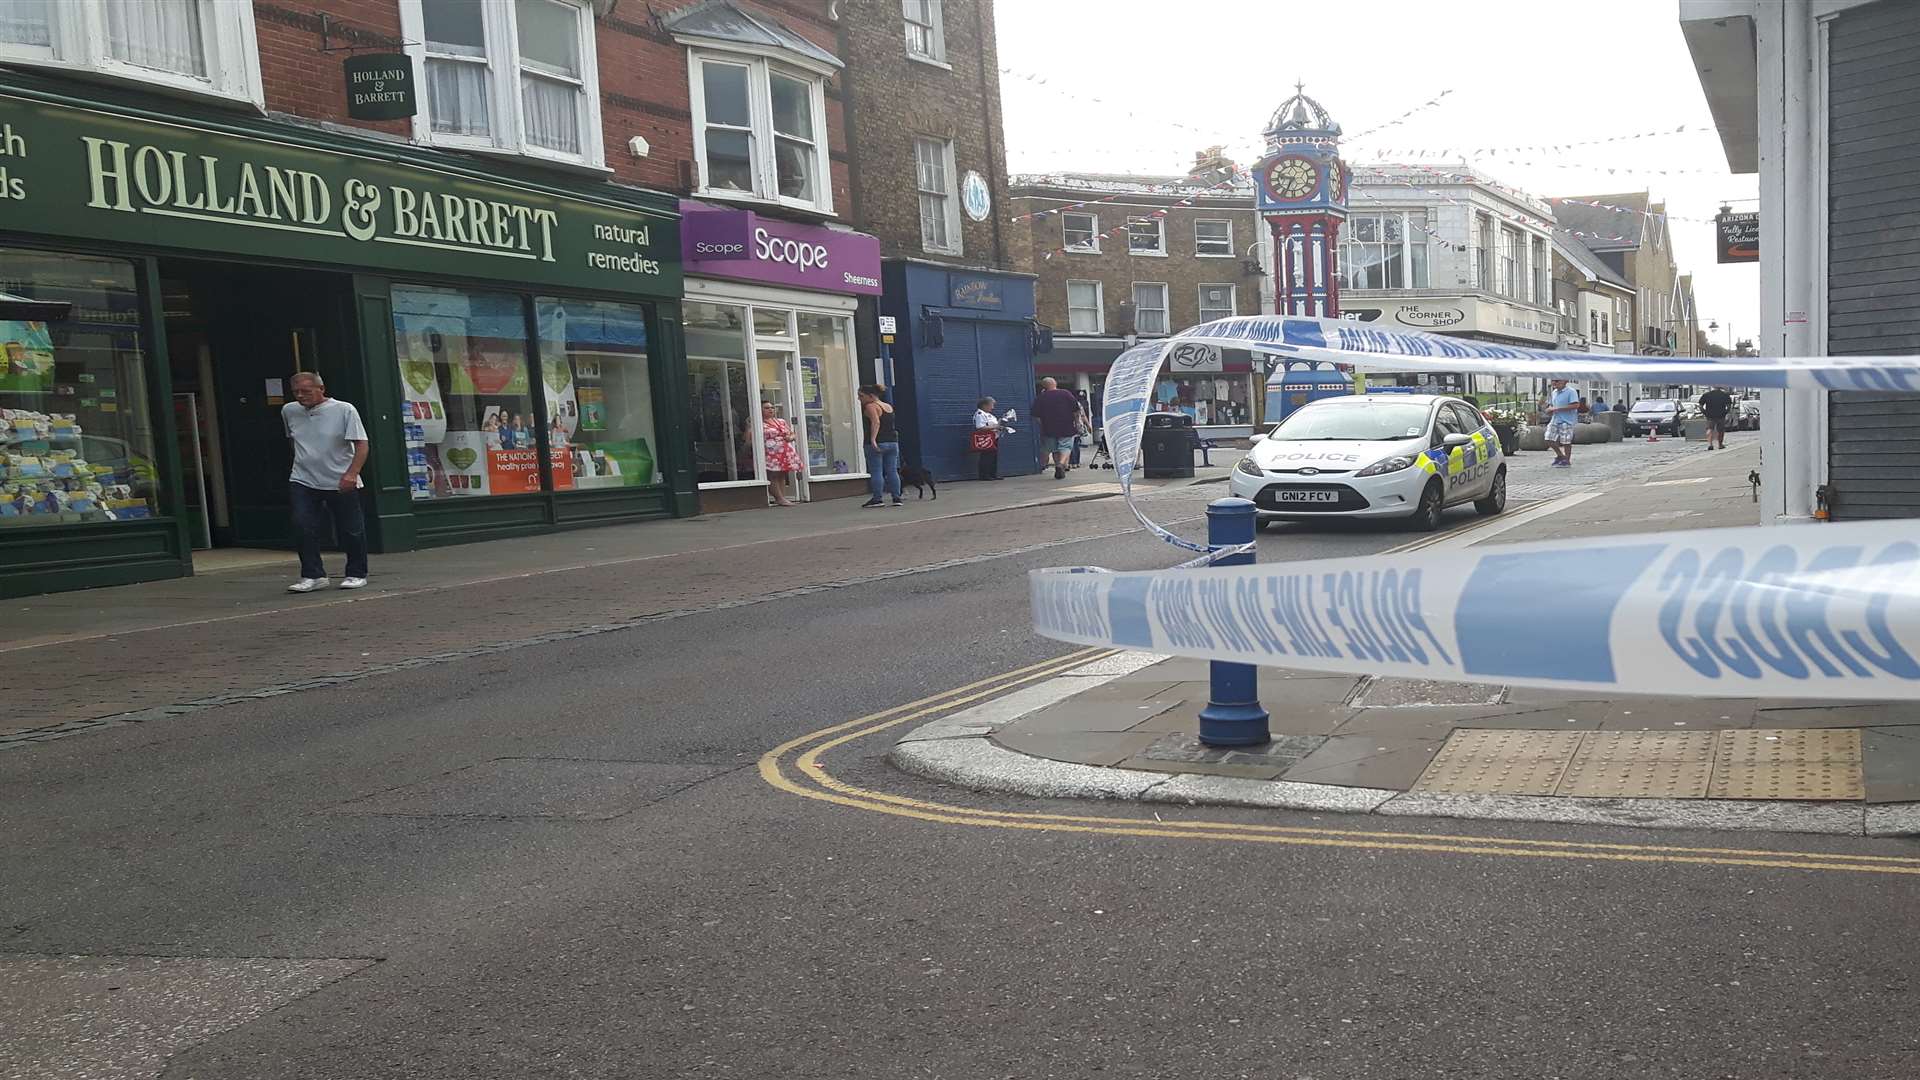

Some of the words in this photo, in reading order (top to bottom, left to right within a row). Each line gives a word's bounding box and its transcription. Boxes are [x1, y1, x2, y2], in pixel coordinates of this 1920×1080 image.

[353, 69, 405, 83] HOLLAND
[374, 81, 385, 92] &
[355, 91, 405, 105] BARRETT
[80, 136, 332, 226] HOLLAND
[341, 178, 382, 242] &
[389, 186, 559, 263] BARRETT
[594, 224, 649, 247] natural
[696, 241, 744, 255] Scope
[755, 227, 829, 273] Scope
[587, 251, 660, 276] remedies
[844, 271, 879, 288] Sheerness
[1400, 305, 1419, 313] THE
[1408, 311, 1452, 319] CORNER
[1433, 318, 1461, 326] SHOP
[496, 453, 509, 462] THE
[1271, 453, 1361, 462] POLICE
[1449, 461, 1490, 490] POLICE
[1281, 492, 1306, 501] GN12
[1309, 492, 1332, 501] FCV
